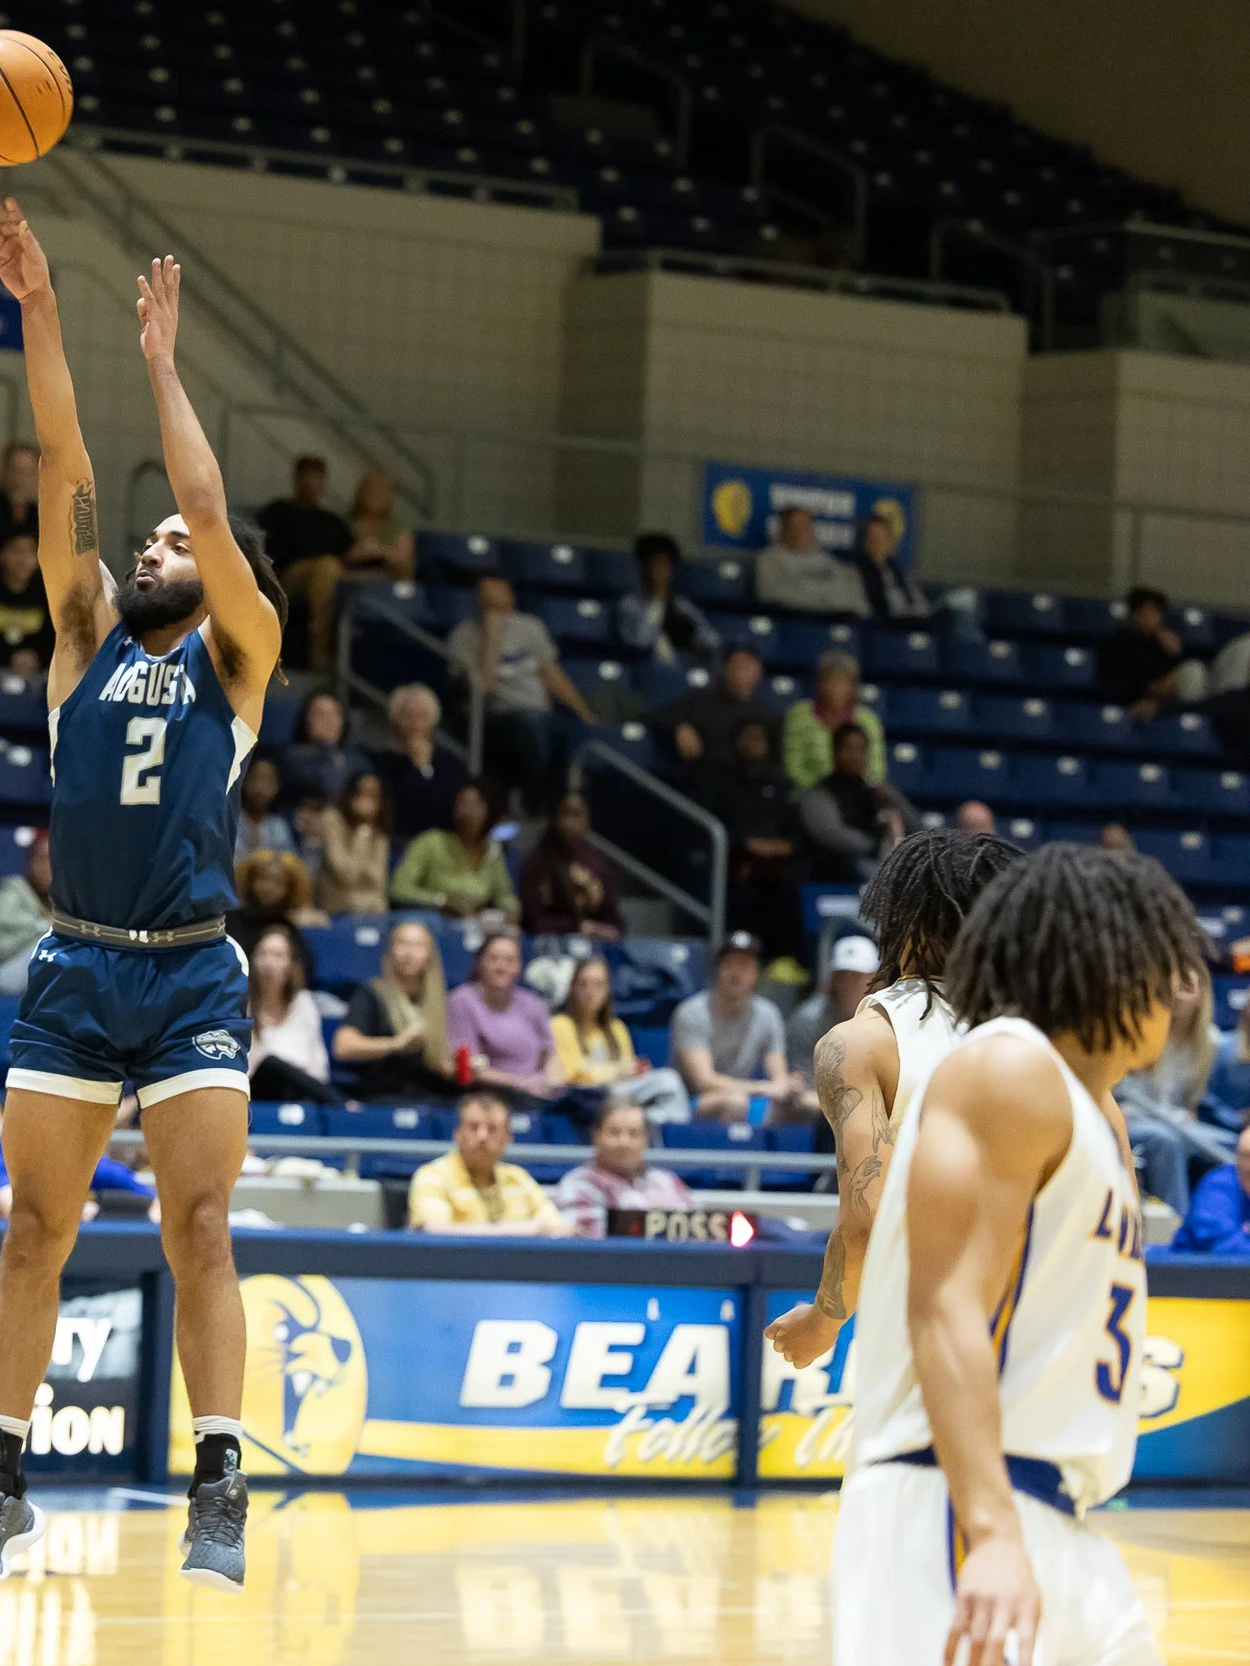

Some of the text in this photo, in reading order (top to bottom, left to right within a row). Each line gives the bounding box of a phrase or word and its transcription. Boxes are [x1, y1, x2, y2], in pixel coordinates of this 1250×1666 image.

[120, 716, 167, 805] 2
[644, 1211, 727, 1243] POSS
[1094, 1281, 1136, 1406] 3
